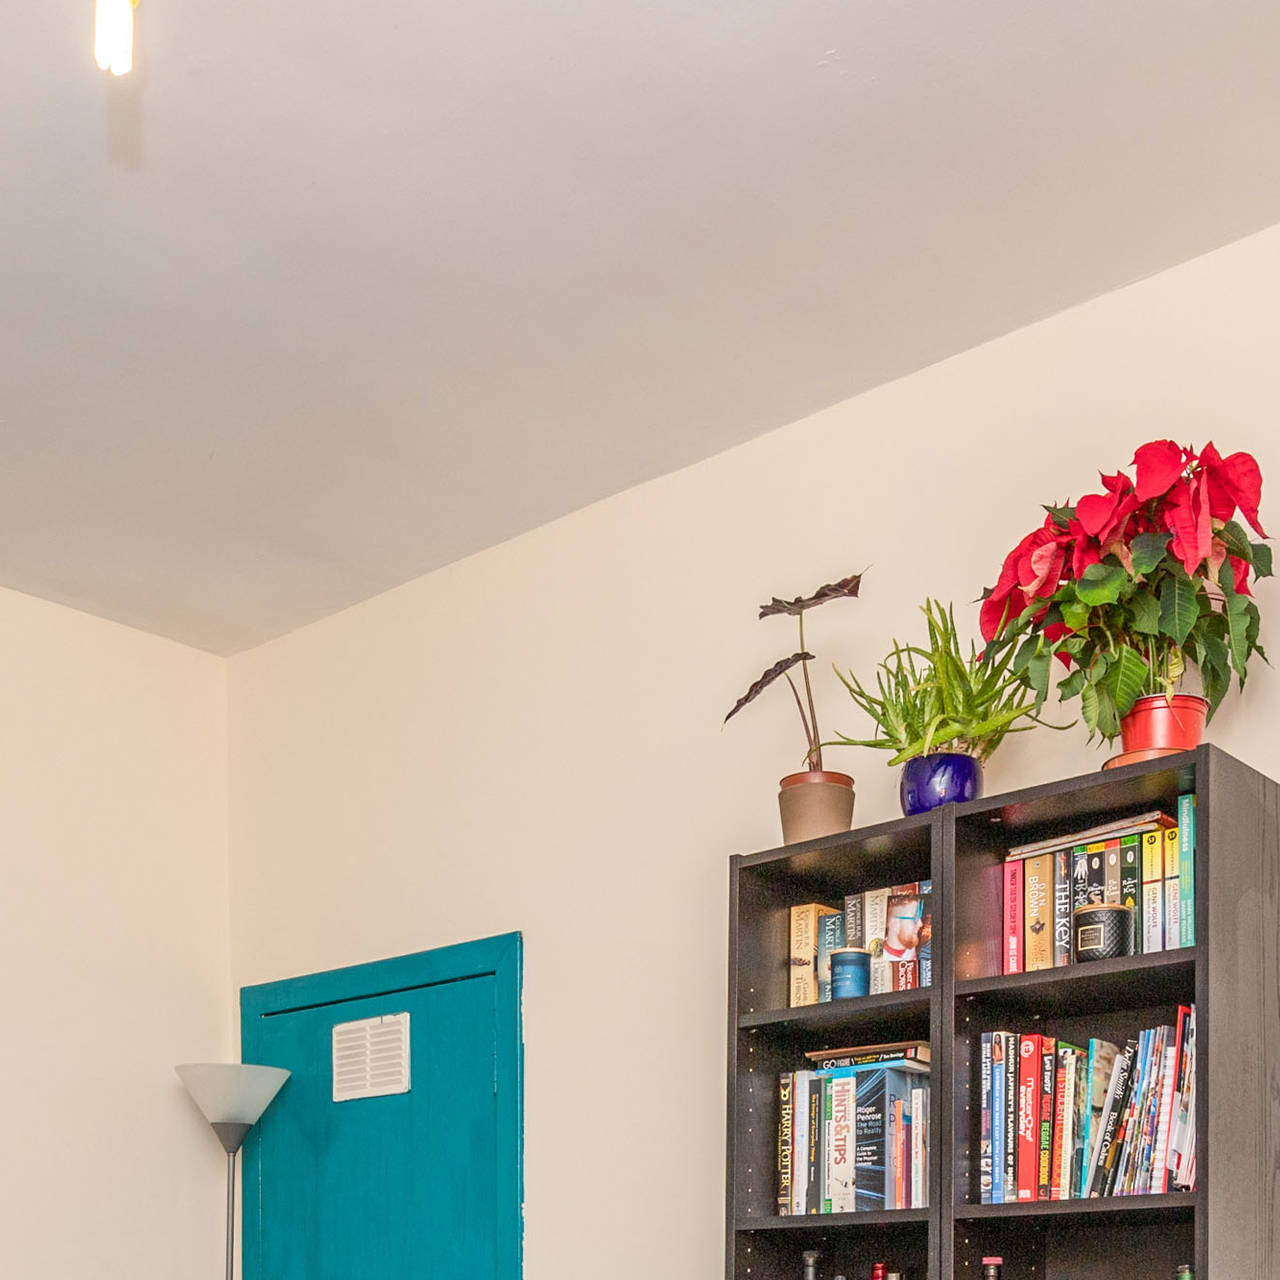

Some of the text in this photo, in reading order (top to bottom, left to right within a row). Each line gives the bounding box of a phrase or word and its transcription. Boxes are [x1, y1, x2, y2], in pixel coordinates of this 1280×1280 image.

[1028, 875, 1039, 918] BROWN
[1039, 882, 1047, 907] DAN
[1055, 880, 1069, 913] THE
[796, 908, 804, 951] MARTIN
[847, 900, 856, 940] MARTIN
[871, 895, 880, 936] MARTIN
[823, 1060, 837, 1071] GO
[1007, 1036, 1015, 1072] MADHUR
[856, 1106, 876, 1115] Roger
[1007, 1073, 1015, 1112] JAFFREY'S
[1018, 1085, 1026, 1136] everyday
[1025, 1077, 1034, 1142] MasterChef
[856, 1113, 881, 1122] Penrose
[1007, 1113, 1015, 1153] FLAVOURS
[1108, 1110, 1119, 1129] Book
[780, 1103, 793, 1188] HARRY POTTER
[1039, 1094, 1051, 1186] REGGAE REGGAE COOKBOOK
